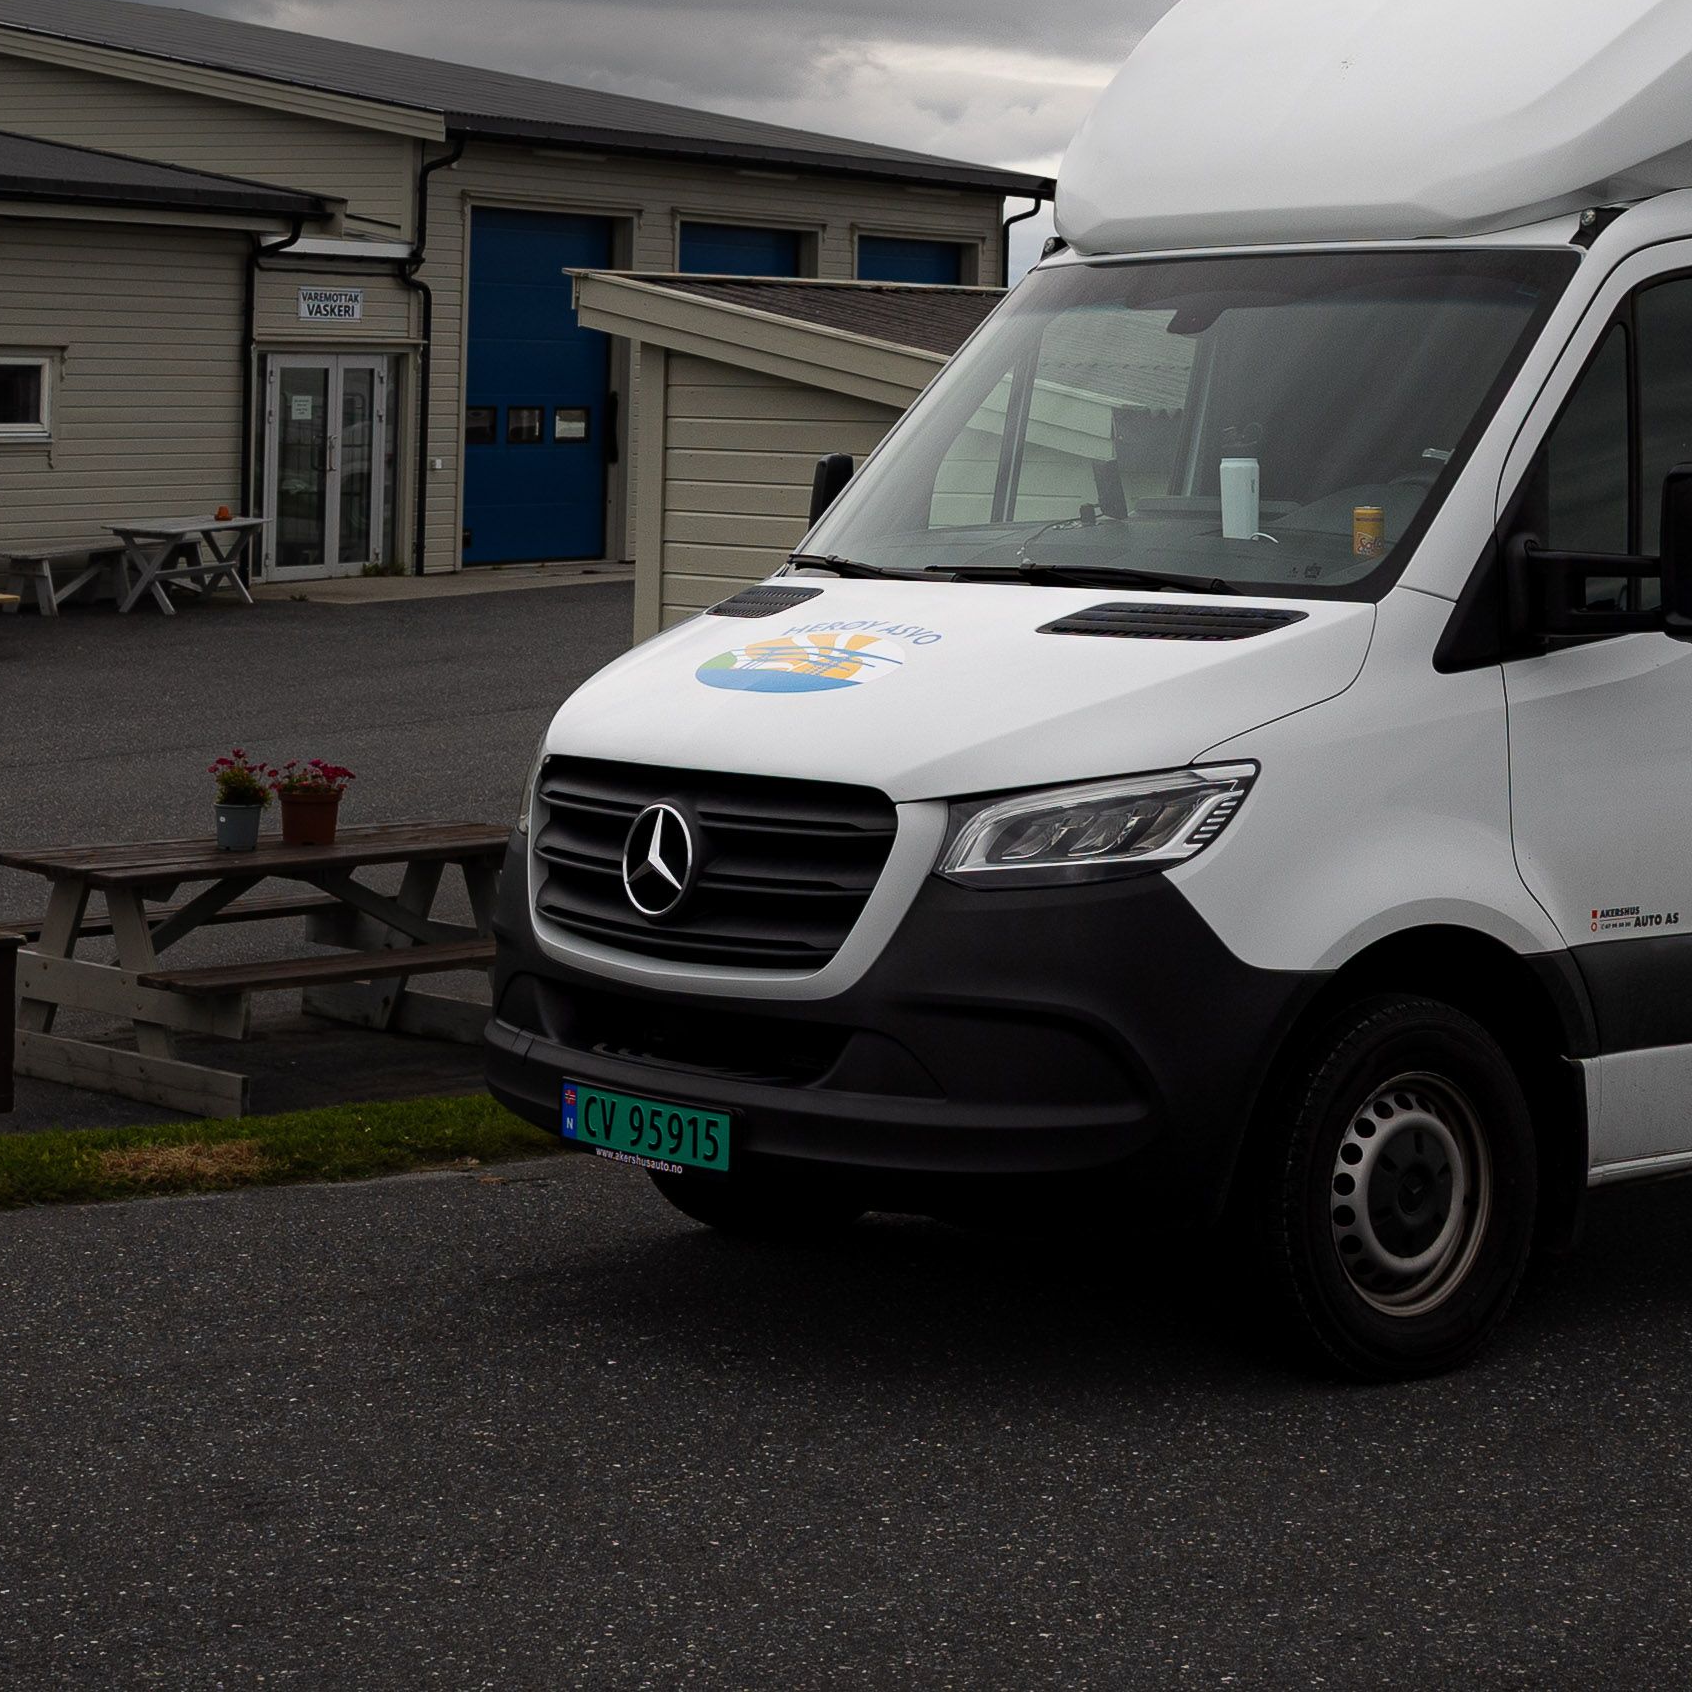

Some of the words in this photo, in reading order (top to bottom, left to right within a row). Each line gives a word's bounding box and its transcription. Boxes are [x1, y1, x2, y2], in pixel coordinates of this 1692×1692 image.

[301, 292, 360, 303] VAREMOTTAK
[306, 303, 355, 317] VASKERI
[781, 620, 881, 636] HERØY
[875, 623, 942, 646] ASVO
[1600, 906, 1639, 919] AKERSHUS
[1634, 915, 1662, 928] AUTO
[1665, 912, 1679, 924] AS
[566, 1116, 573, 1129] N
[584, 1094, 616, 1141] CV
[628, 1104, 720, 1162] 95915
[596, 1146, 683, 1175] www.akershusauto.no
